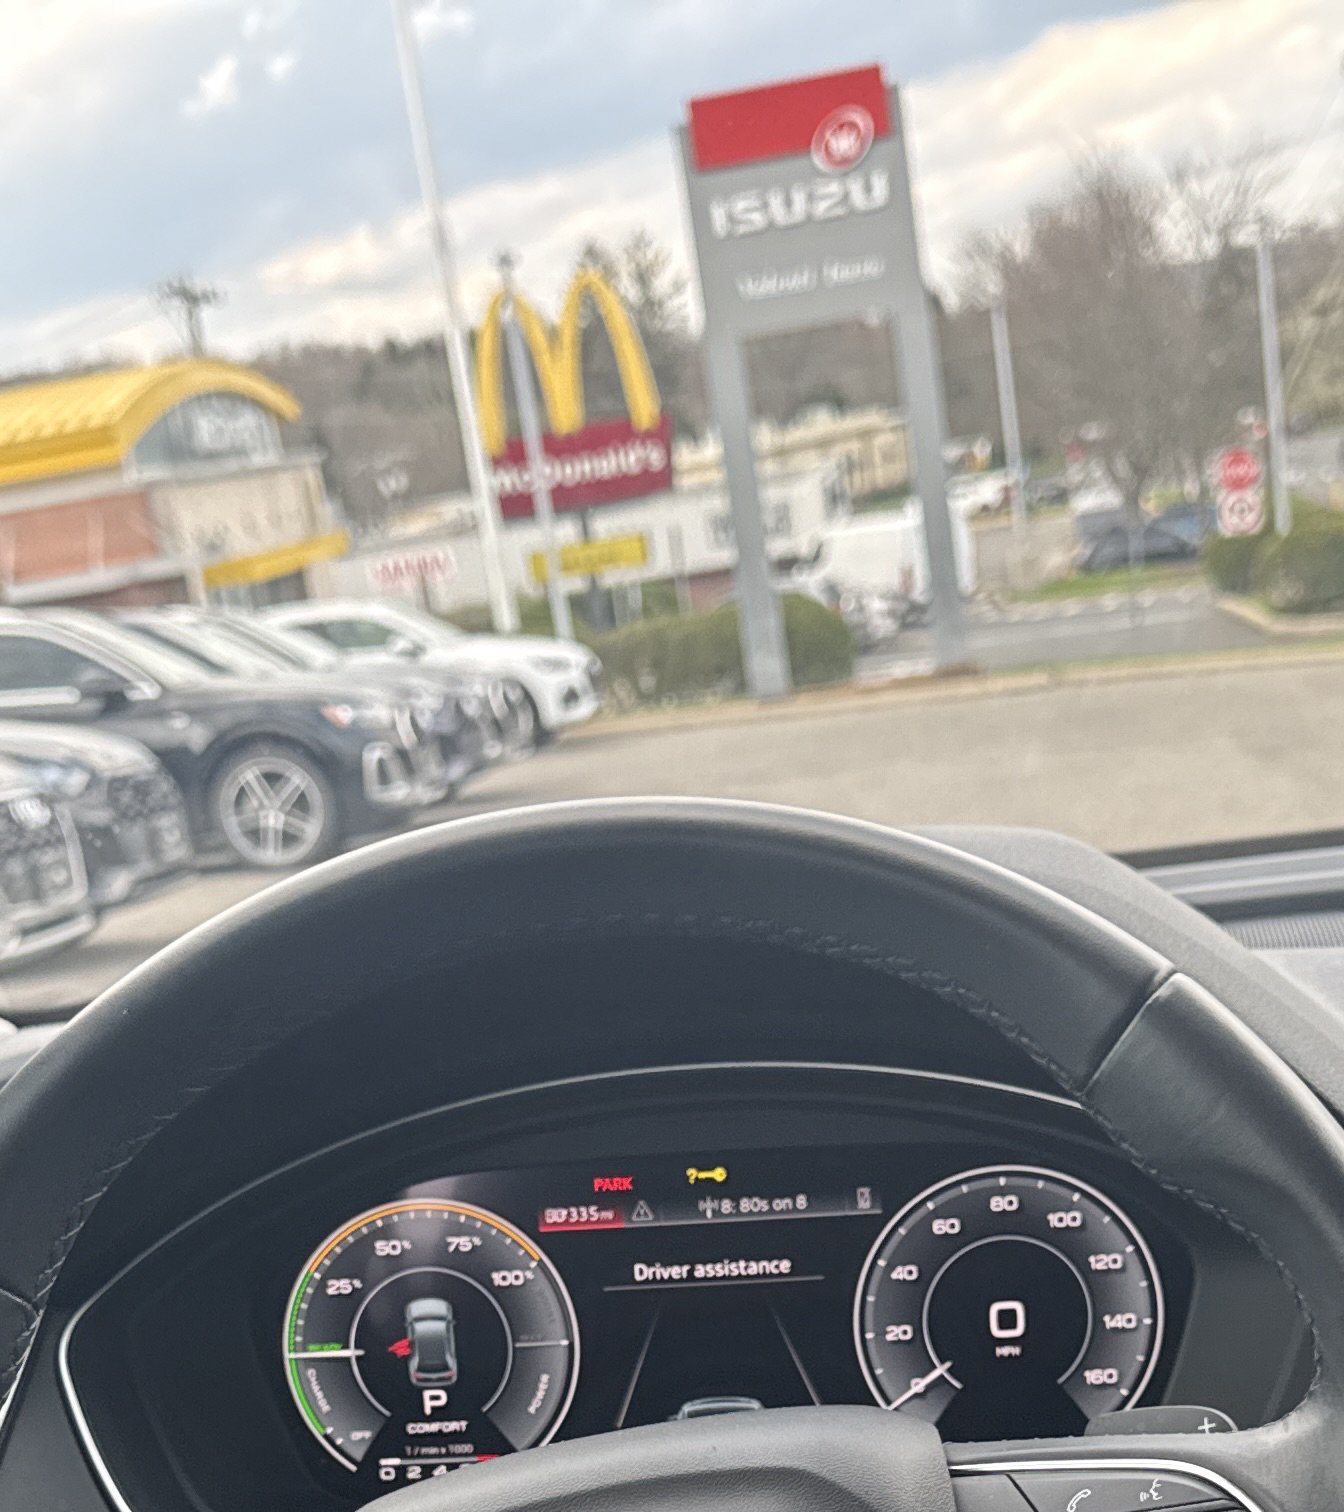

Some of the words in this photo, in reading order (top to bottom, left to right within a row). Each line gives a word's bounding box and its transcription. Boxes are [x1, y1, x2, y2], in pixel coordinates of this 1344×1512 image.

[710, 168, 890, 239] ISUZU
[593, 1176, 634, 1192] PARK
[772, 1197, 793, 1211] on
[795, 1194, 807, 1210] 8
[989, 1195, 1019, 1212] 80
[932, 1217, 961, 1235] 60
[1046, 1211, 1082, 1228] 100
[374, 1239, 412, 1256] 50%
[446, 1236, 482, 1253] 75%
[633, 1262, 691, 1282] Driver
[693, 1258, 792, 1279] assistance
[1088, 1253, 1123, 1270] 120
[491, 1270, 535, 1286] 100%
[890, 1264, 918, 1281] 40
[325, 1279, 363, 1295] 25%
[989, 1300, 1026, 1339] 0
[1102, 1312, 1137, 1329] 140
[885, 1324, 913, 1341] 20
[995, 1345, 1022, 1358] MPH
[1083, 1368, 1118, 1385] 160
[307, 1368, 331, 1414] CHARGE
[527, 1373, 550, 1414] POWER
[422, 1390, 448, 1416] P
[406, 1419, 469, 1434] COMFORT
[379, 1466, 395, 1481] 0
[407, 1465, 422, 1479] 2
